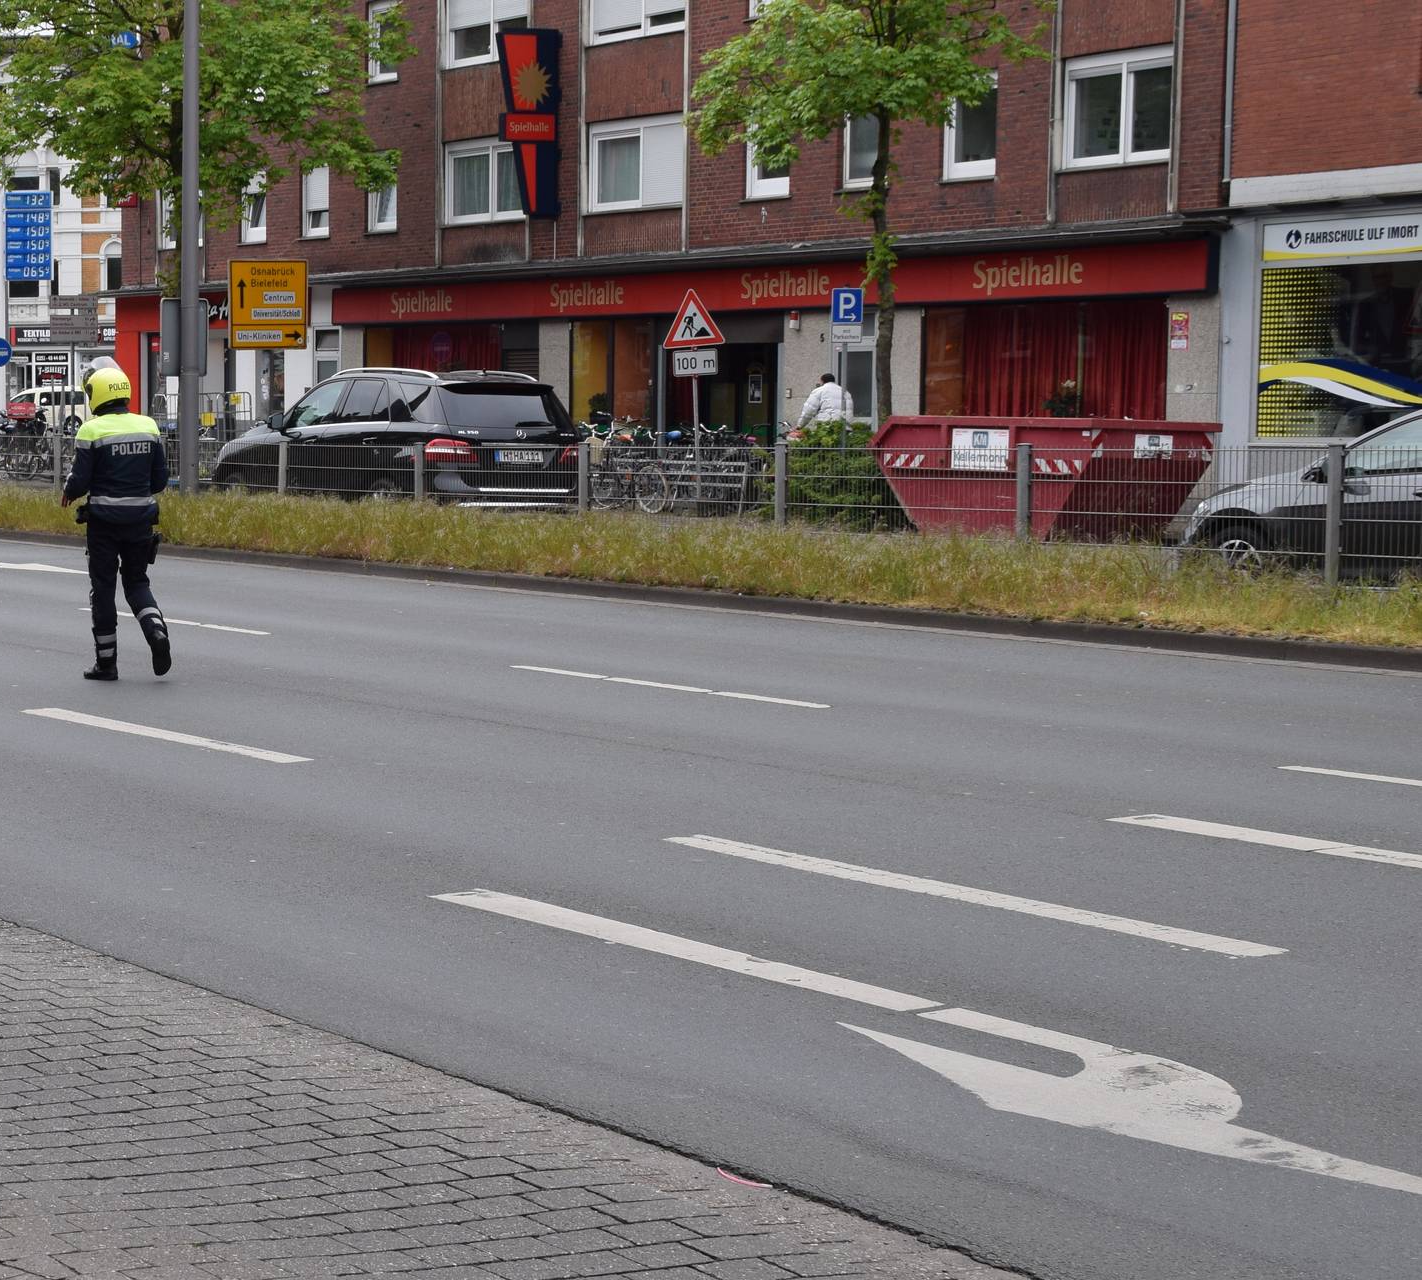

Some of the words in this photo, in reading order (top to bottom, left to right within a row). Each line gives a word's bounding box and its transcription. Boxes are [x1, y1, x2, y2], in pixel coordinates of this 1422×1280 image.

[509, 121, 550, 134] Spielhalle
[1304, 229, 1365, 245] FAHRSCHULE
[1367, 227, 1385, 241] ULF
[1387, 225, 1419, 239] IMORT
[250, 266, 295, 276] Osnabrück
[972, 254, 1083, 296] Spielhalle
[250, 279, 288, 288] Bielefeld
[740, 268, 830, 305] Spielhalle
[264, 294, 294, 303] Centrum
[549, 280, 624, 313] Spielhalle
[390, 289, 453, 319] Spielhalle
[839, 293, 856, 319] P
[253, 310, 301, 318] Universität/Schloß
[237, 332, 281, 341] Uni-Kliniken
[676, 357, 697, 370] 100
[703, 358, 715, 368] m
[38, 366, 66, 375] T-SHIRT
[111, 442, 151, 456] POLIZEI
